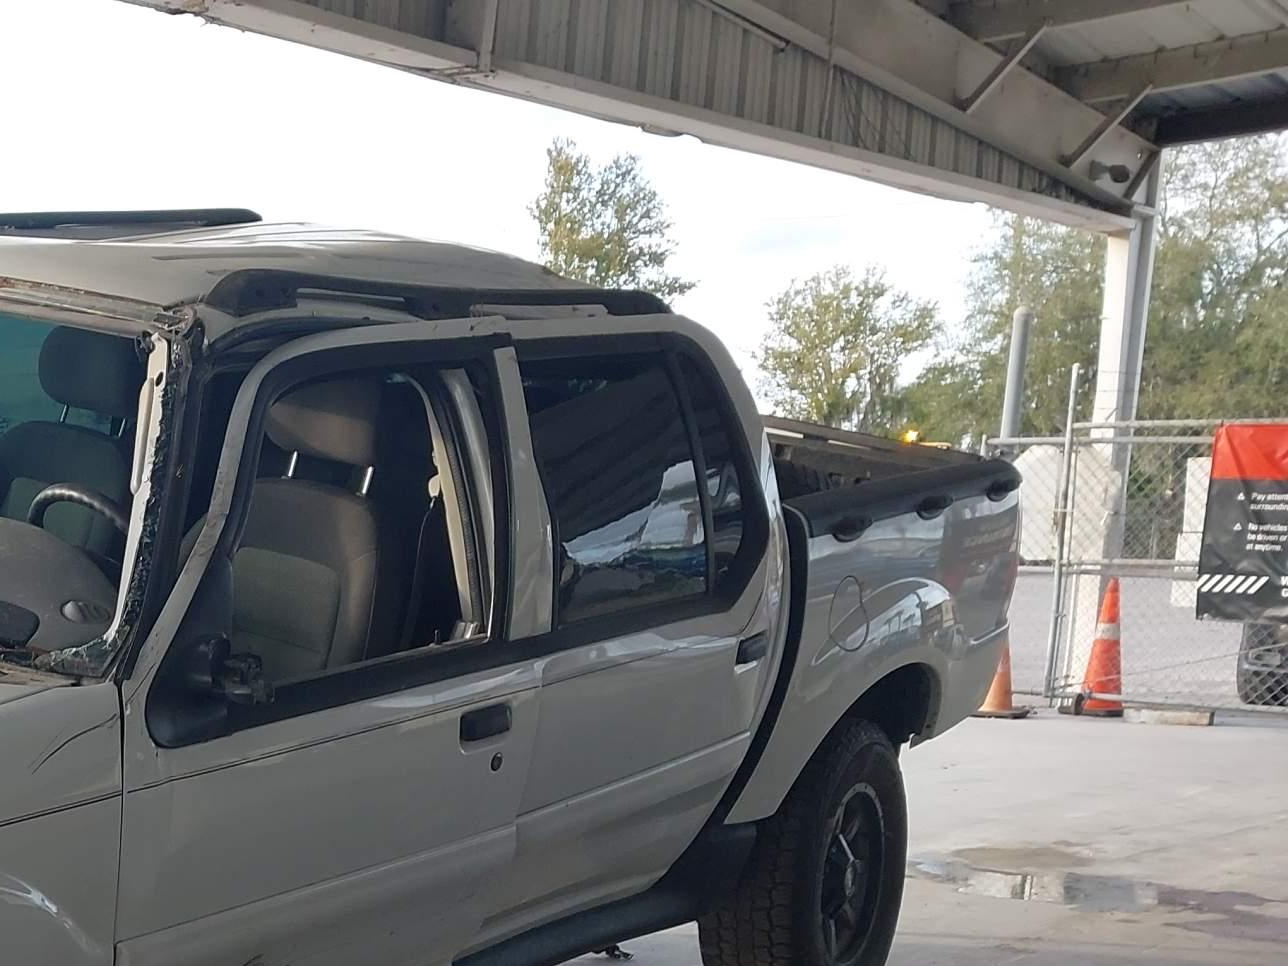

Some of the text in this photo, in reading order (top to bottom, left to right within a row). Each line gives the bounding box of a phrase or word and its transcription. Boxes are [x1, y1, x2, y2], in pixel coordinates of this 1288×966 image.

[1252, 492, 1266, 502] Pay
[1248, 522, 1288, 532] No vehicles
[1247, 533, 1257, 541] be
[1257, 533, 1279, 541] driven
